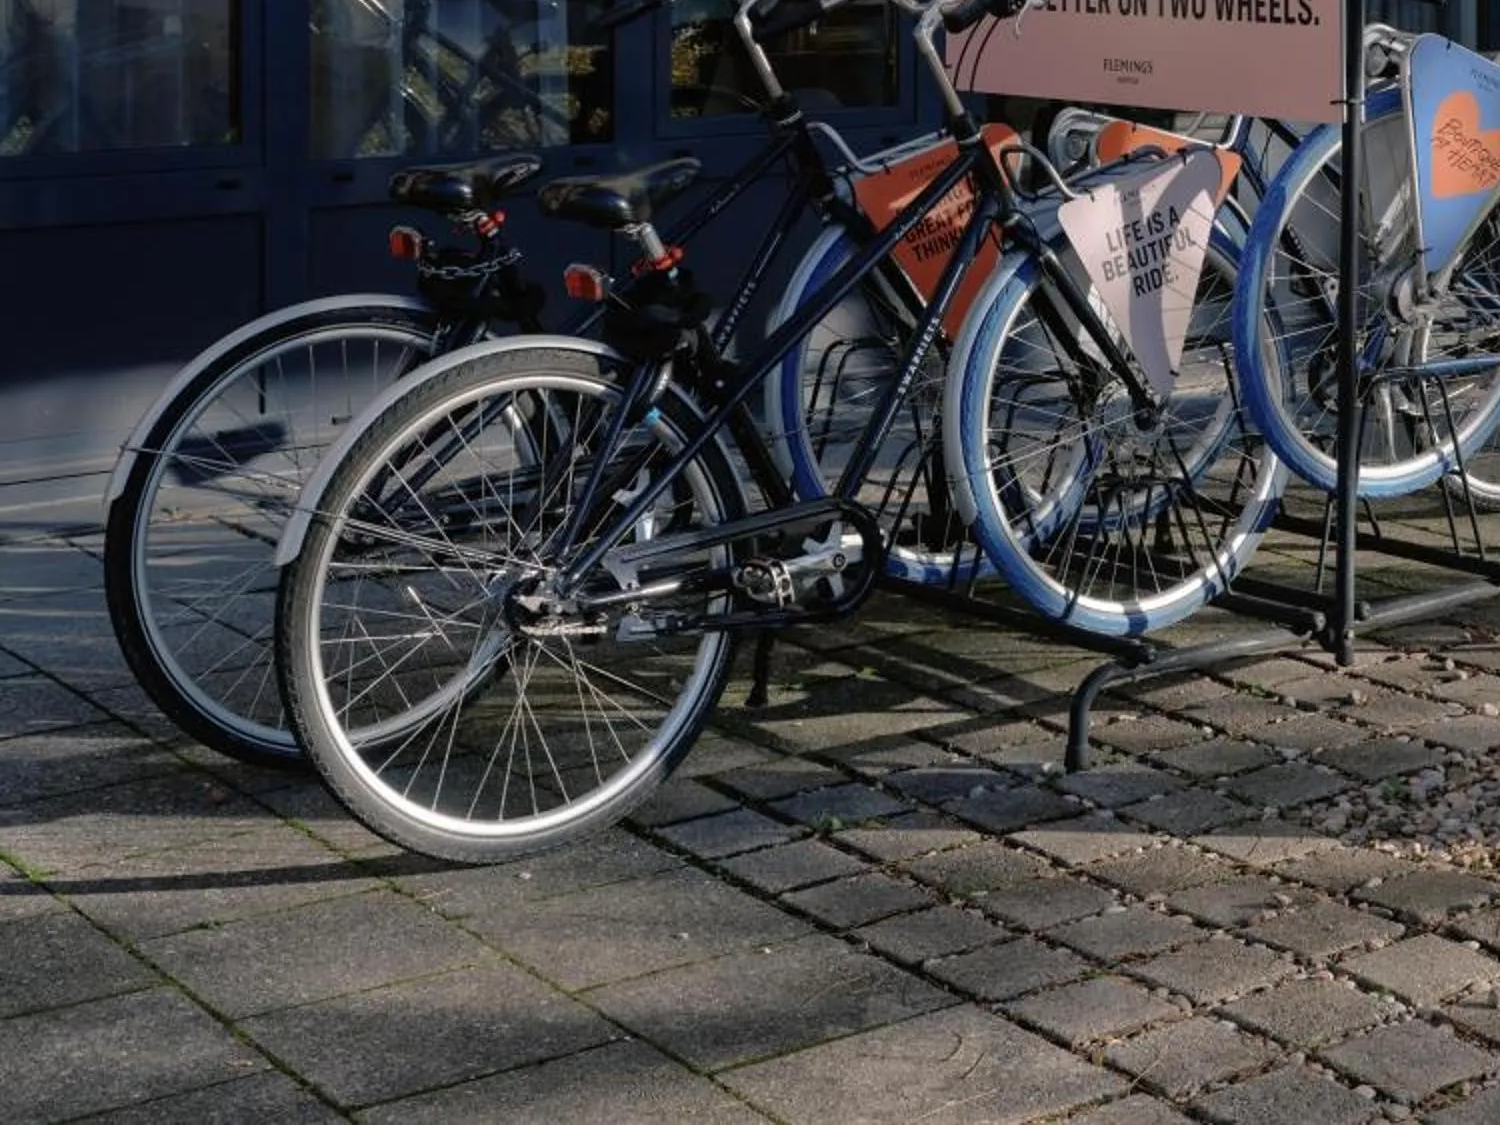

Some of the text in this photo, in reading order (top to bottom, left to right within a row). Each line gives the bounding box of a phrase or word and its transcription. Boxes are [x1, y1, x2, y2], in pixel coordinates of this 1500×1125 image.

[1101, 226, 1197, 283] BEAUTIFUL
[1105, 206, 1181, 253] LIFE IS A
